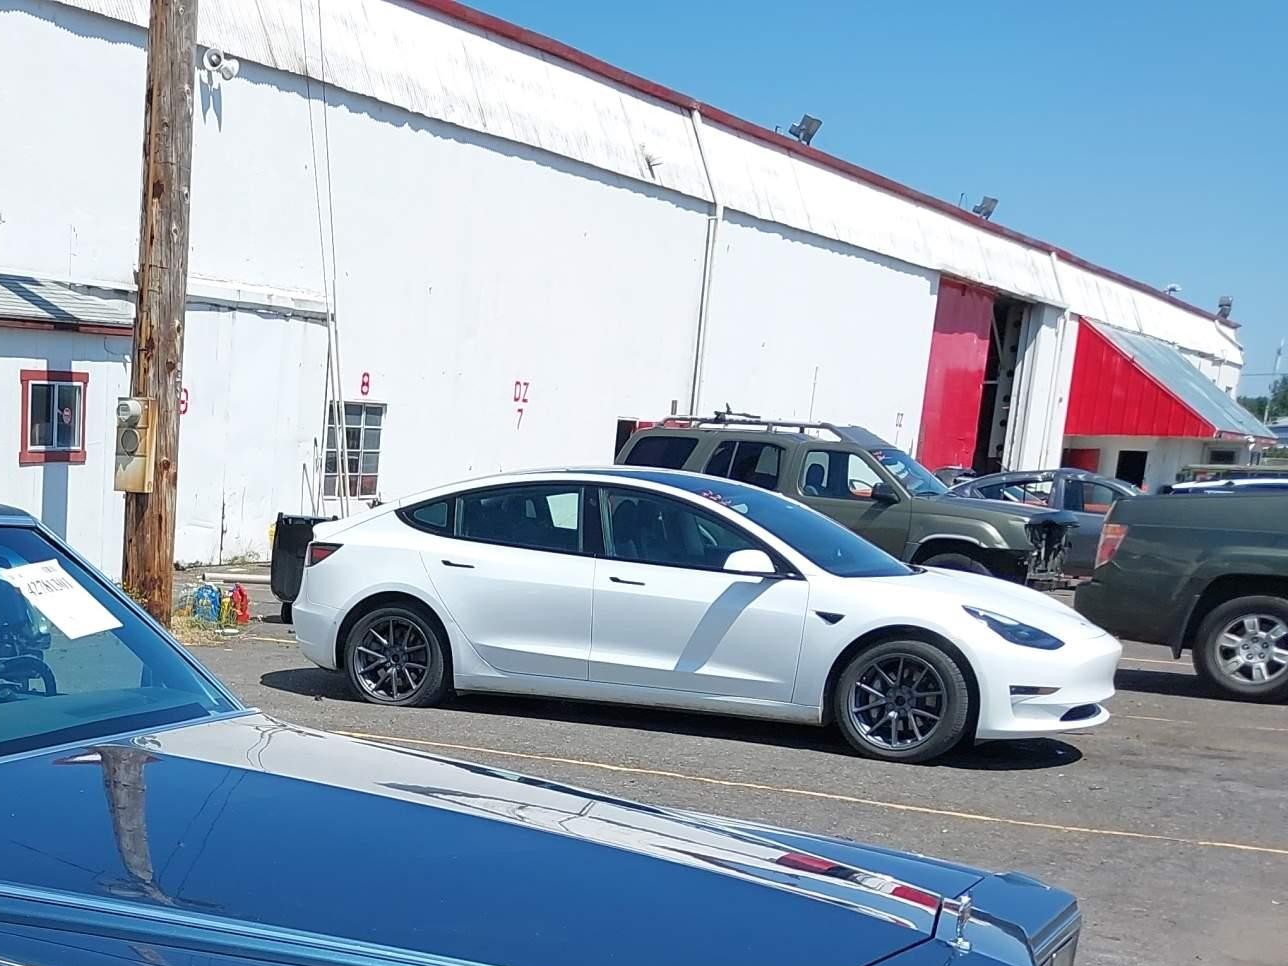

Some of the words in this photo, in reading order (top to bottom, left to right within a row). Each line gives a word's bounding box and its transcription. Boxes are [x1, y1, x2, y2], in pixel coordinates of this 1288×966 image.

[361, 372, 370, 396] 8
[514, 381, 530, 403] DZ
[517, 408, 523, 430] 7
